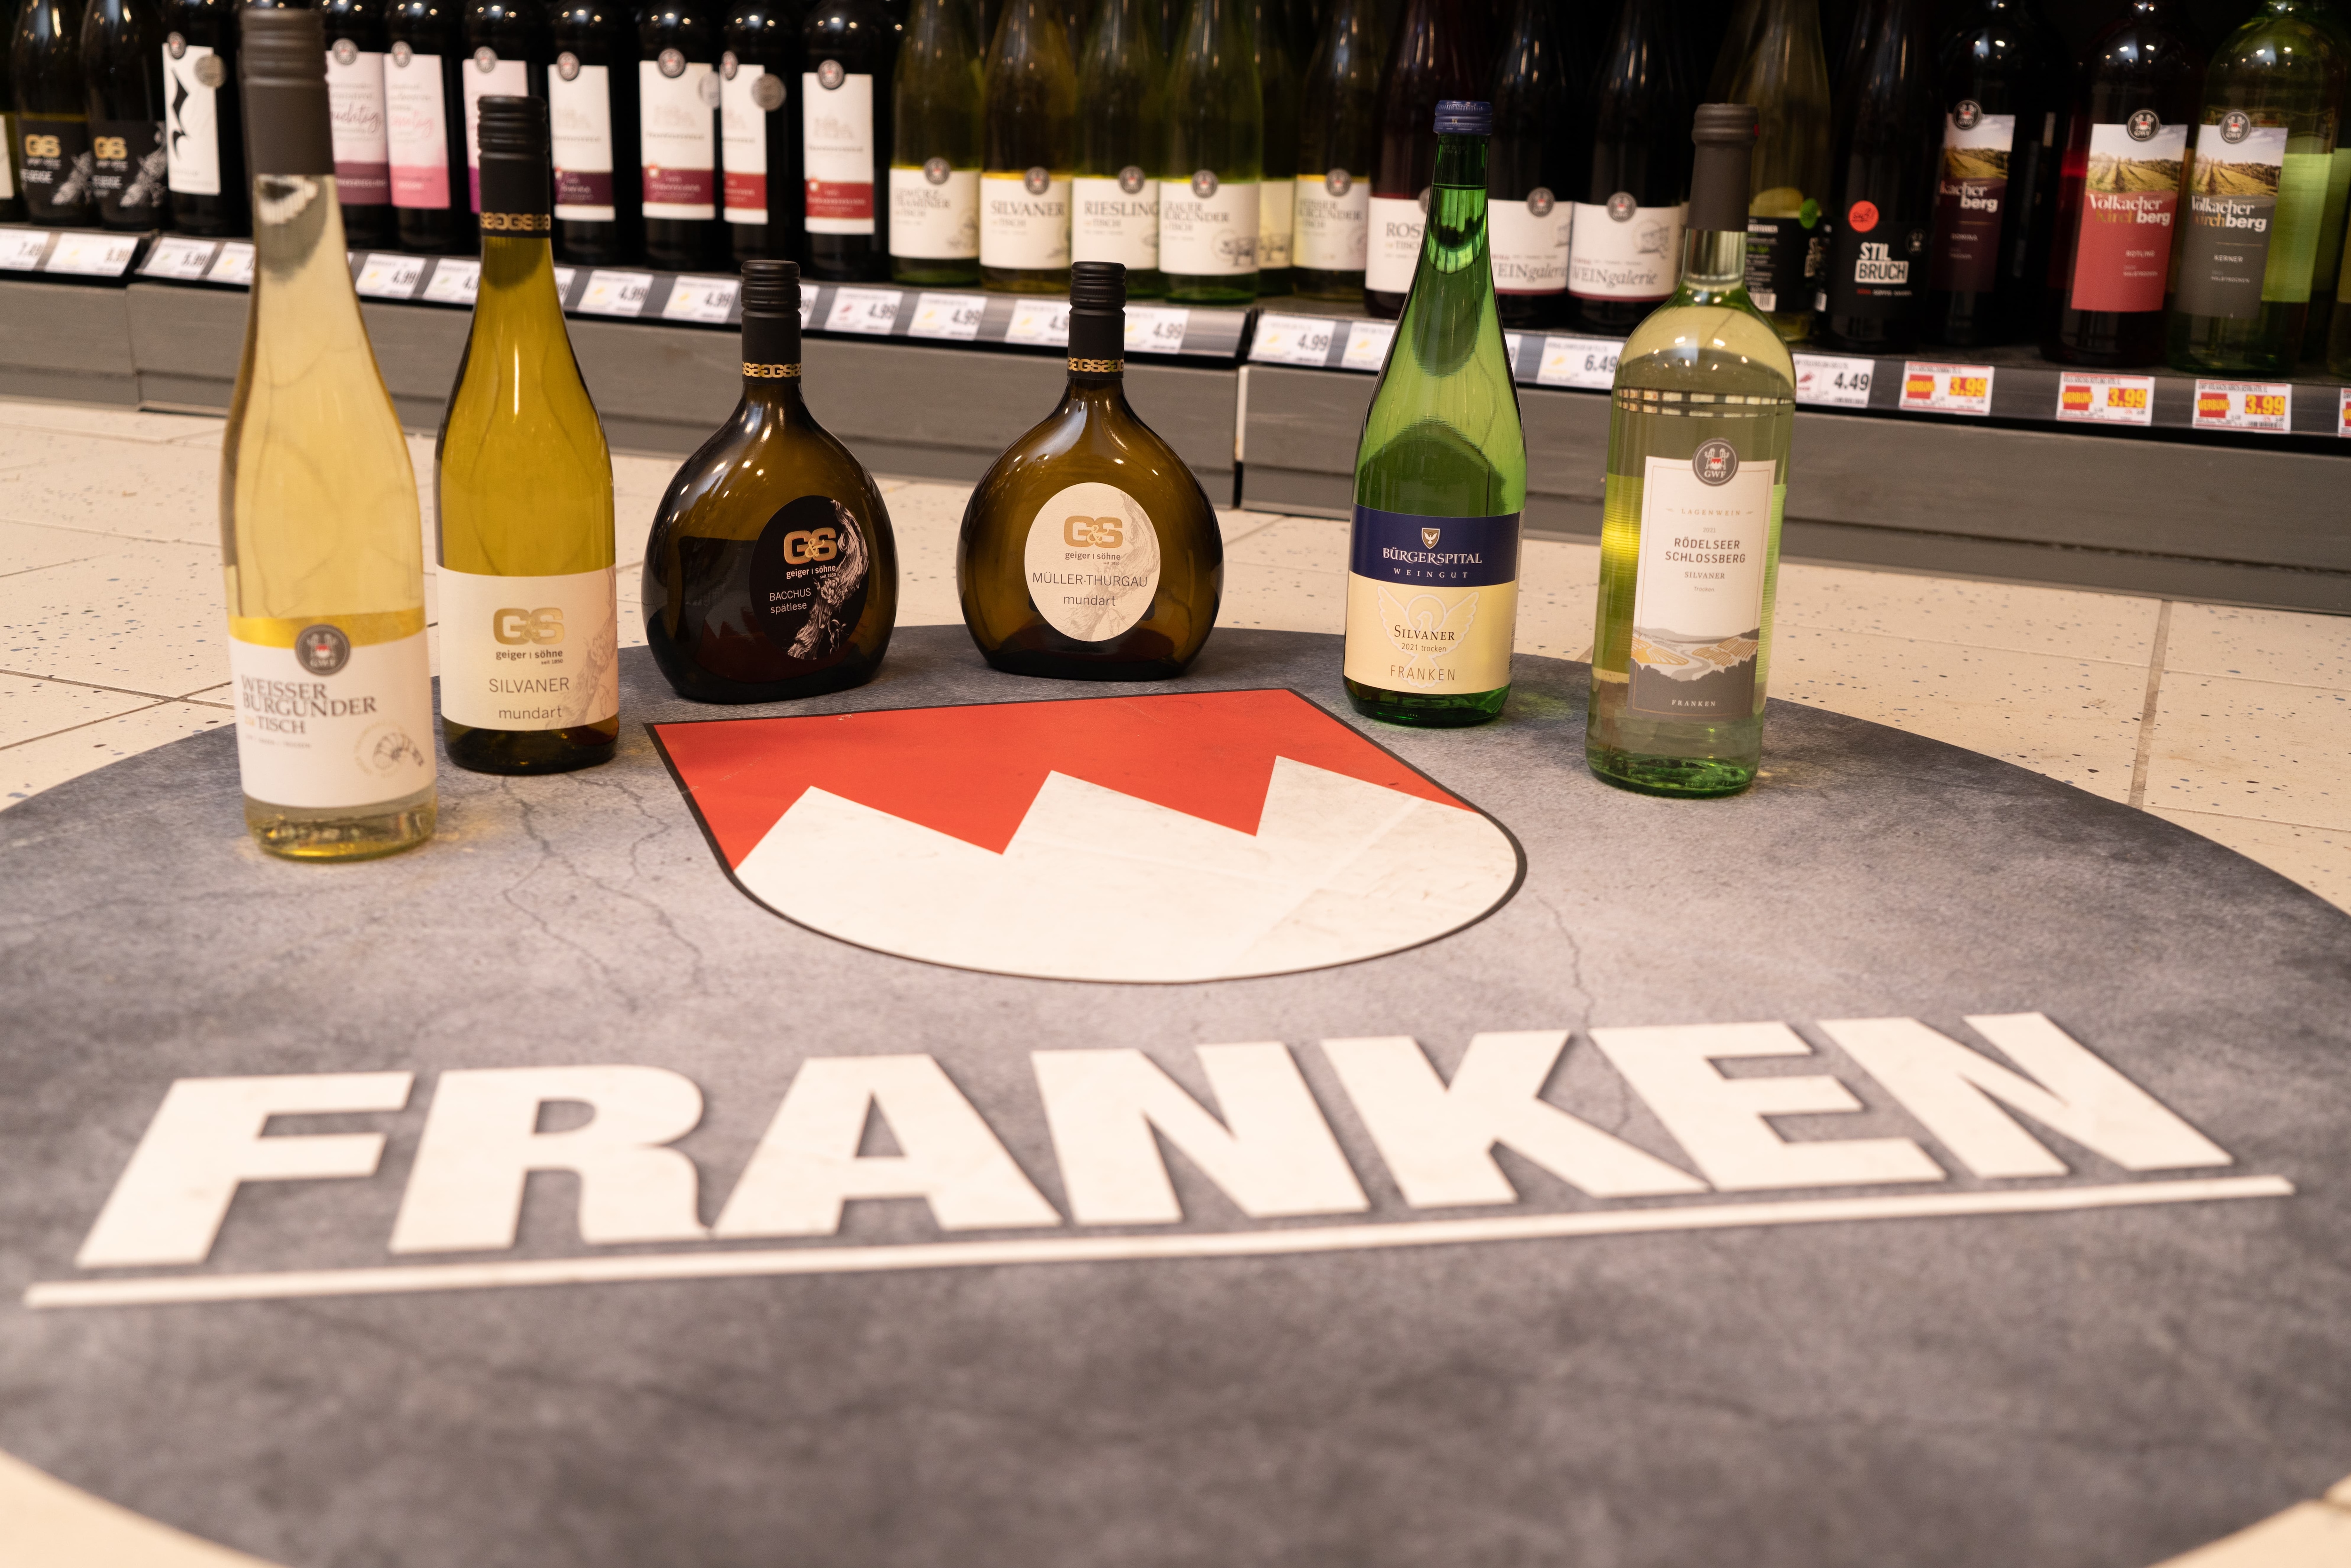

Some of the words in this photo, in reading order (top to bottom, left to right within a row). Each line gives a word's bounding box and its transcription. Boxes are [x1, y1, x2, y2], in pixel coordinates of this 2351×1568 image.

[991, 201, 1065, 216] SILVANER
[1386, 222, 1426, 239] ROS
[1859, 242, 1892, 260] STIL
[2213, 254, 2243, 263] KERNER
[1859, 262, 1905, 280] BRUCH
[1297, 333, 1329, 352] 4.99
[1585, 355, 1617, 373] 6.49
[1834, 372, 1870, 391] 4.49
[1949, 377, 1987, 397] 3.99
[2107, 387, 2147, 409] 3.99
[2245, 394, 2286, 415] 3.99
[784, 528, 837, 565] G&S
[1674, 536, 1740, 550] RÖDELSEER
[1065, 552, 1090, 560] geiger
[1097, 552, 1120, 560] söhne
[1382, 547, 1483, 566] BÜRGERSPITAL
[1665, 551, 1746, 563] SCHLOSSBERG
[786, 567, 810, 579] geiger
[815, 564, 836, 574] söhne
[1032, 571, 1148, 587] MÜLLER-THURGAU
[1393, 568, 1468, 578] WEINGUT
[769, 588, 811, 602] BACCHUS
[1064, 595, 1116, 607] mundart
[770, 602, 807, 615] spätlese
[496, 651, 526, 661] geiger
[535, 649, 563, 659] söhne
[1401, 643, 1418, 651] 2021
[1390, 665, 1455, 681] FRANKEN
[241, 674, 327, 700] WEISSER
[489, 677, 570, 693] SILVANER
[242, 692, 377, 717] BURGUNDER
[498, 706, 562, 720] mundart
[256, 716, 306, 734] TISCH
[75, 1011, 2234, 1268] FRANKEN
